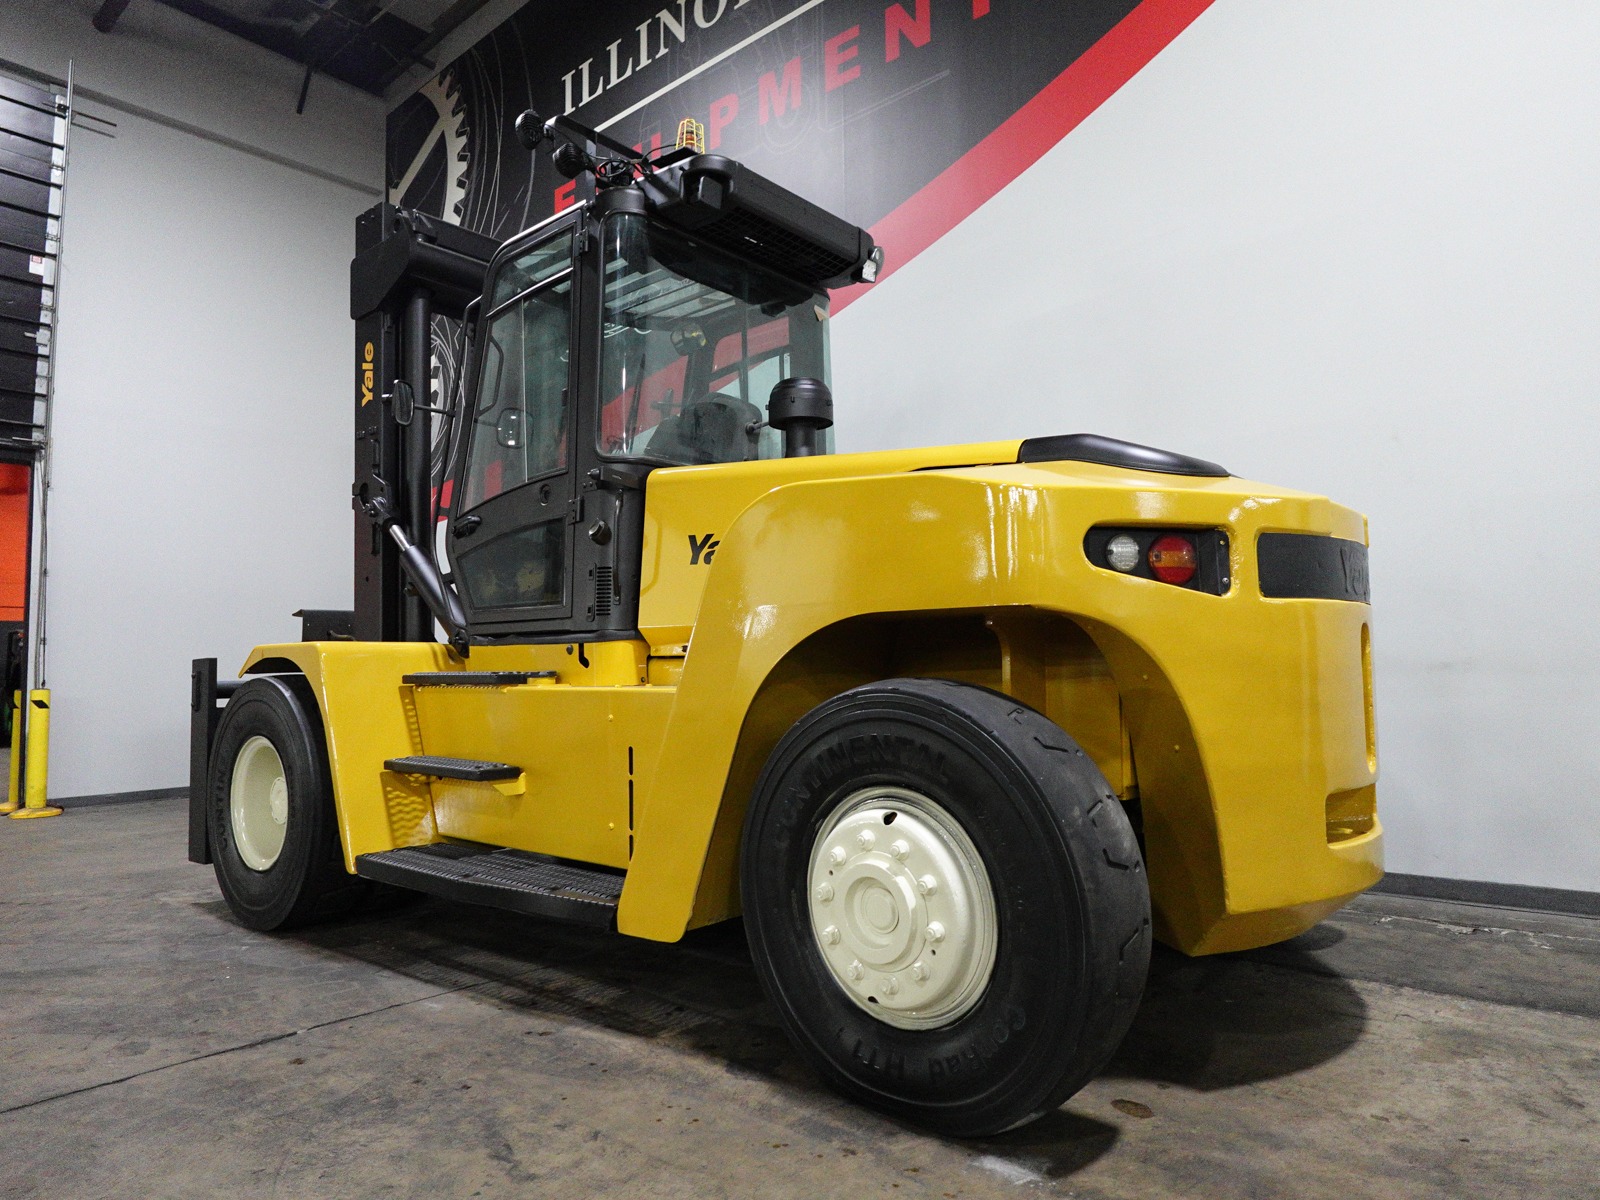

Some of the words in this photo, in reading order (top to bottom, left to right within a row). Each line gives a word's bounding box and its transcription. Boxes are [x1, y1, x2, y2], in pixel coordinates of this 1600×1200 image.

[561, 0, 751, 116] ILLINO
[362, 341, 374, 408] Yale
[774, 733, 948, 848] CONTINENTAL
